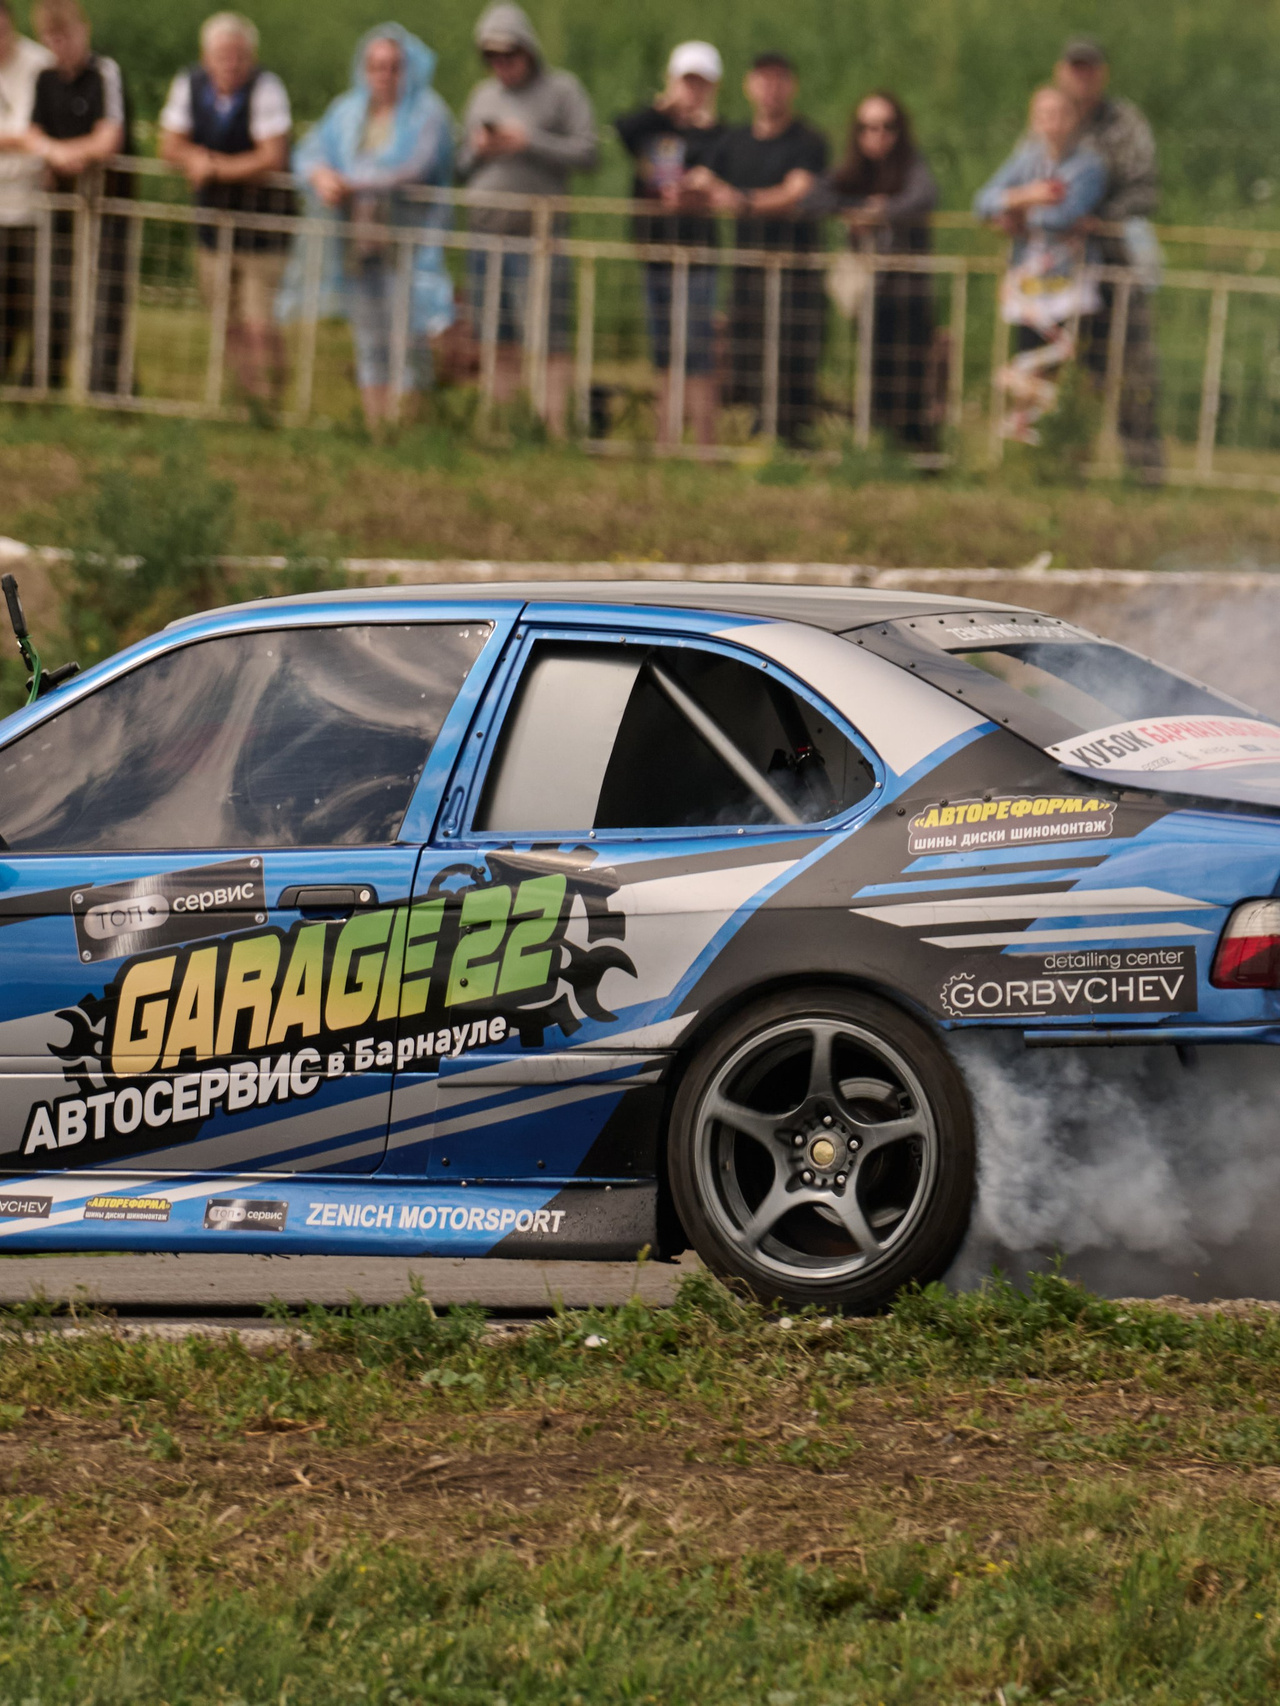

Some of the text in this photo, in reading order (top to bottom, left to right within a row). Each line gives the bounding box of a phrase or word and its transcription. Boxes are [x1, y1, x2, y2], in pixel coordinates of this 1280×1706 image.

[1070, 730, 1154, 768] КУБОК
[173, 883, 255, 912] сервис
[113, 873, 567, 1078] GARAGE 22
[1044, 951, 1184, 971] detailing center
[23, 1015, 508, 1155] АВТОСЕРВИС в Барнауле
[247, 1211, 283, 1221] сервис
[306, 1203, 566, 1233] ZENICH MOTORSPORT
